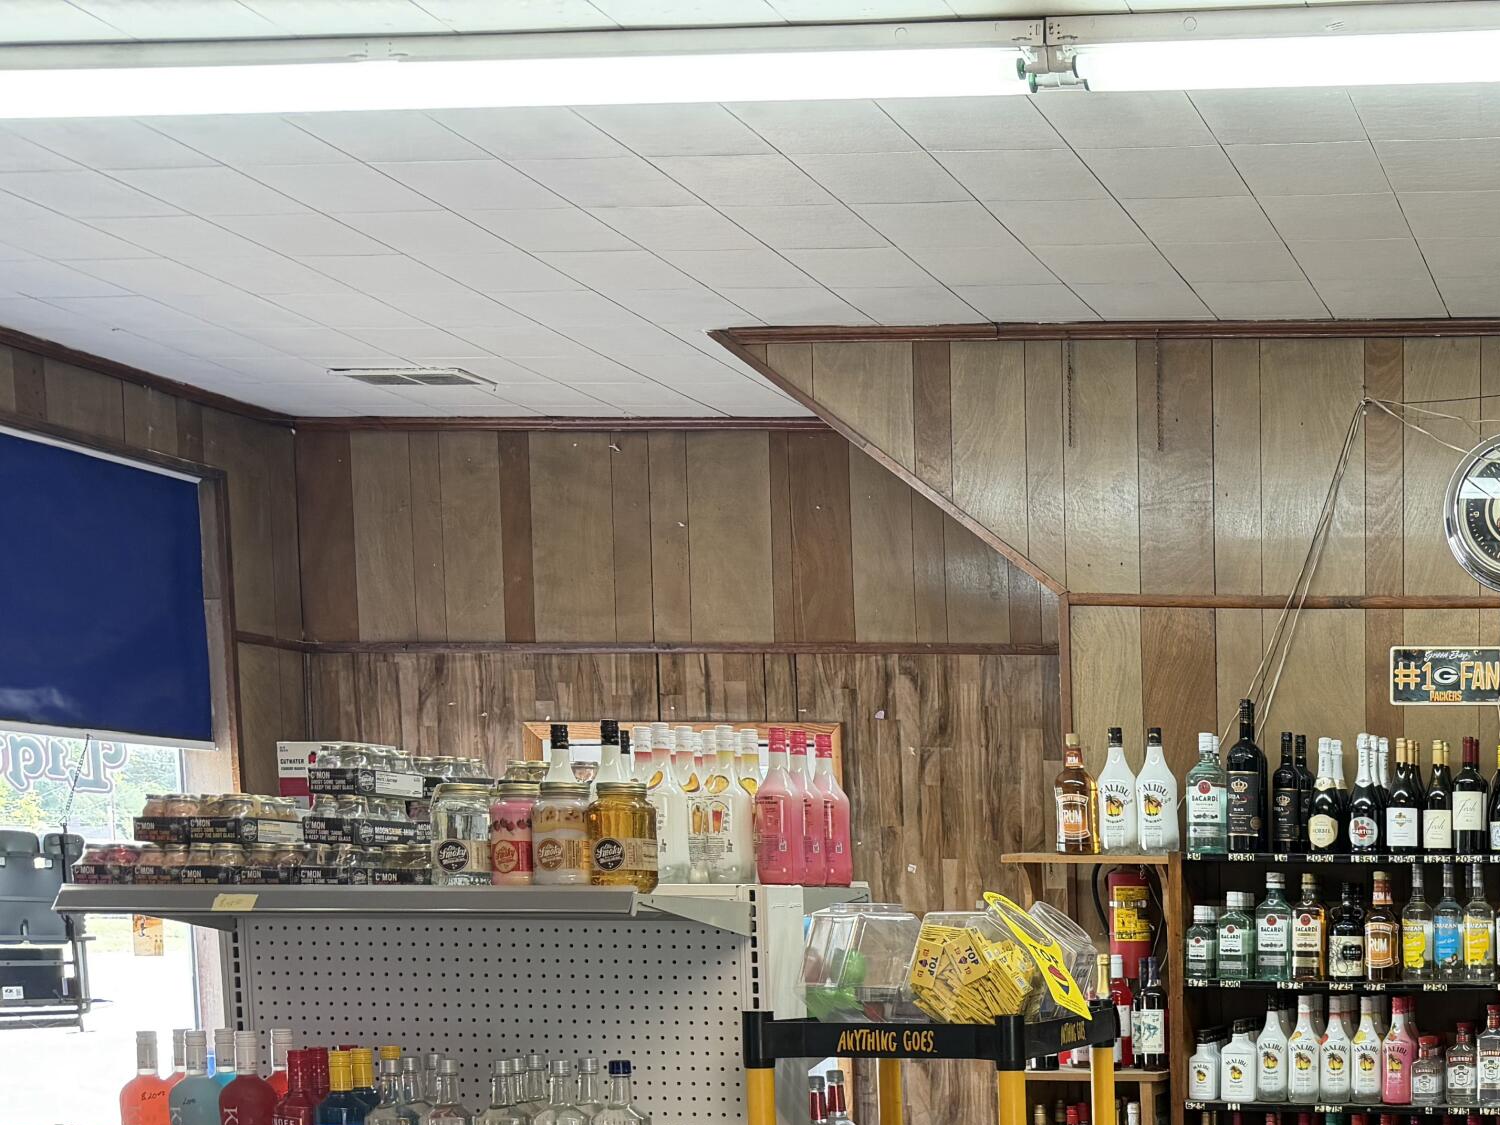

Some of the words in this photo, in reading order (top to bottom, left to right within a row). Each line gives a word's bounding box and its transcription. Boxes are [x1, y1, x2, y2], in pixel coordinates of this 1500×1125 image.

[1424, 650, 1447, 661] Green
[1394, 661, 1436, 690] #1
[1433, 666, 1459, 684] G
[1460, 661, 1500, 690] FAN
[1430, 690, 1462, 702] PACKERS
[310, 770, 330, 779] C'MON
[1063, 810, 1083, 824] RUM
[136, 821, 155, 830] C'MON
[190, 819, 211, 828] C'MON
[305, 822, 326, 830] C'MON
[1187, 853, 1201, 861] 30
[1306, 854, 1334, 862] 2050
[1424, 855, 1450, 863] 1825
[74, 866, 95, 875] C'MON
[964, 946, 979, 966] TOP
[928, 956, 938, 977] TOP
[837, 1029, 897, 1053] ANYTHING
[903, 1030, 935, 1053] GOES
